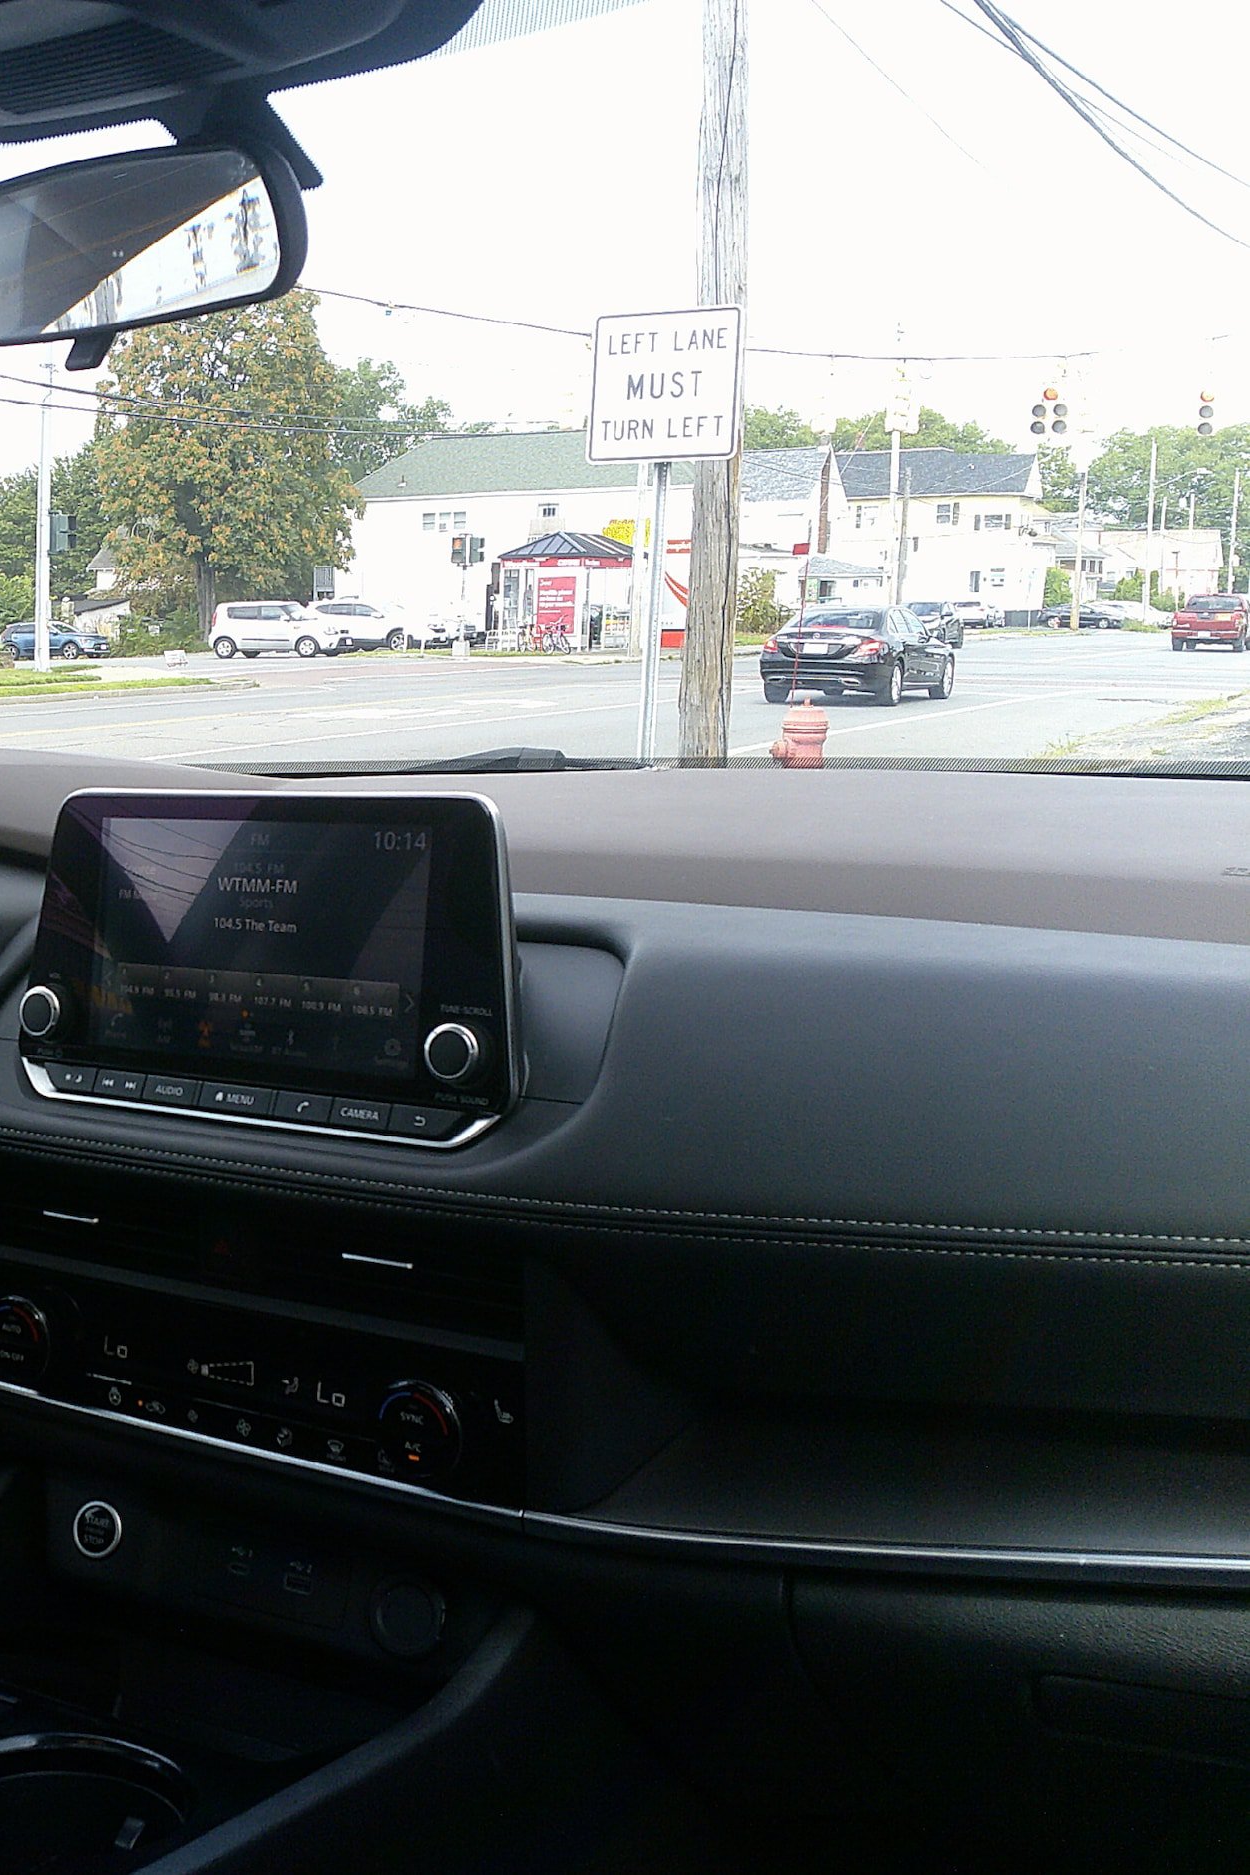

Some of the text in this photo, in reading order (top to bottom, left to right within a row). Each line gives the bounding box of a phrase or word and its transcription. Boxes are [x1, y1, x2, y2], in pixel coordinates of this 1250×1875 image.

[608, 327, 728, 356] LEFT LANE
[626, 370, 703, 401] MUST
[601, 415, 724, 441] TURN LEFT
[374, 830, 427, 851] 10:14
[217, 876, 299, 895] WTMM-FM
[213, 917, 297, 934] 104.5 The Team
[154, 1084, 184, 1096] AUDIO
[225, 1093, 255, 1107] MENU
[339, 1107, 380, 1121] CAMERA
[103, 1335, 129, 1359] Lo
[316, 1380, 346, 1408] Lo
[399, 1412, 425, 1426] SYNC
